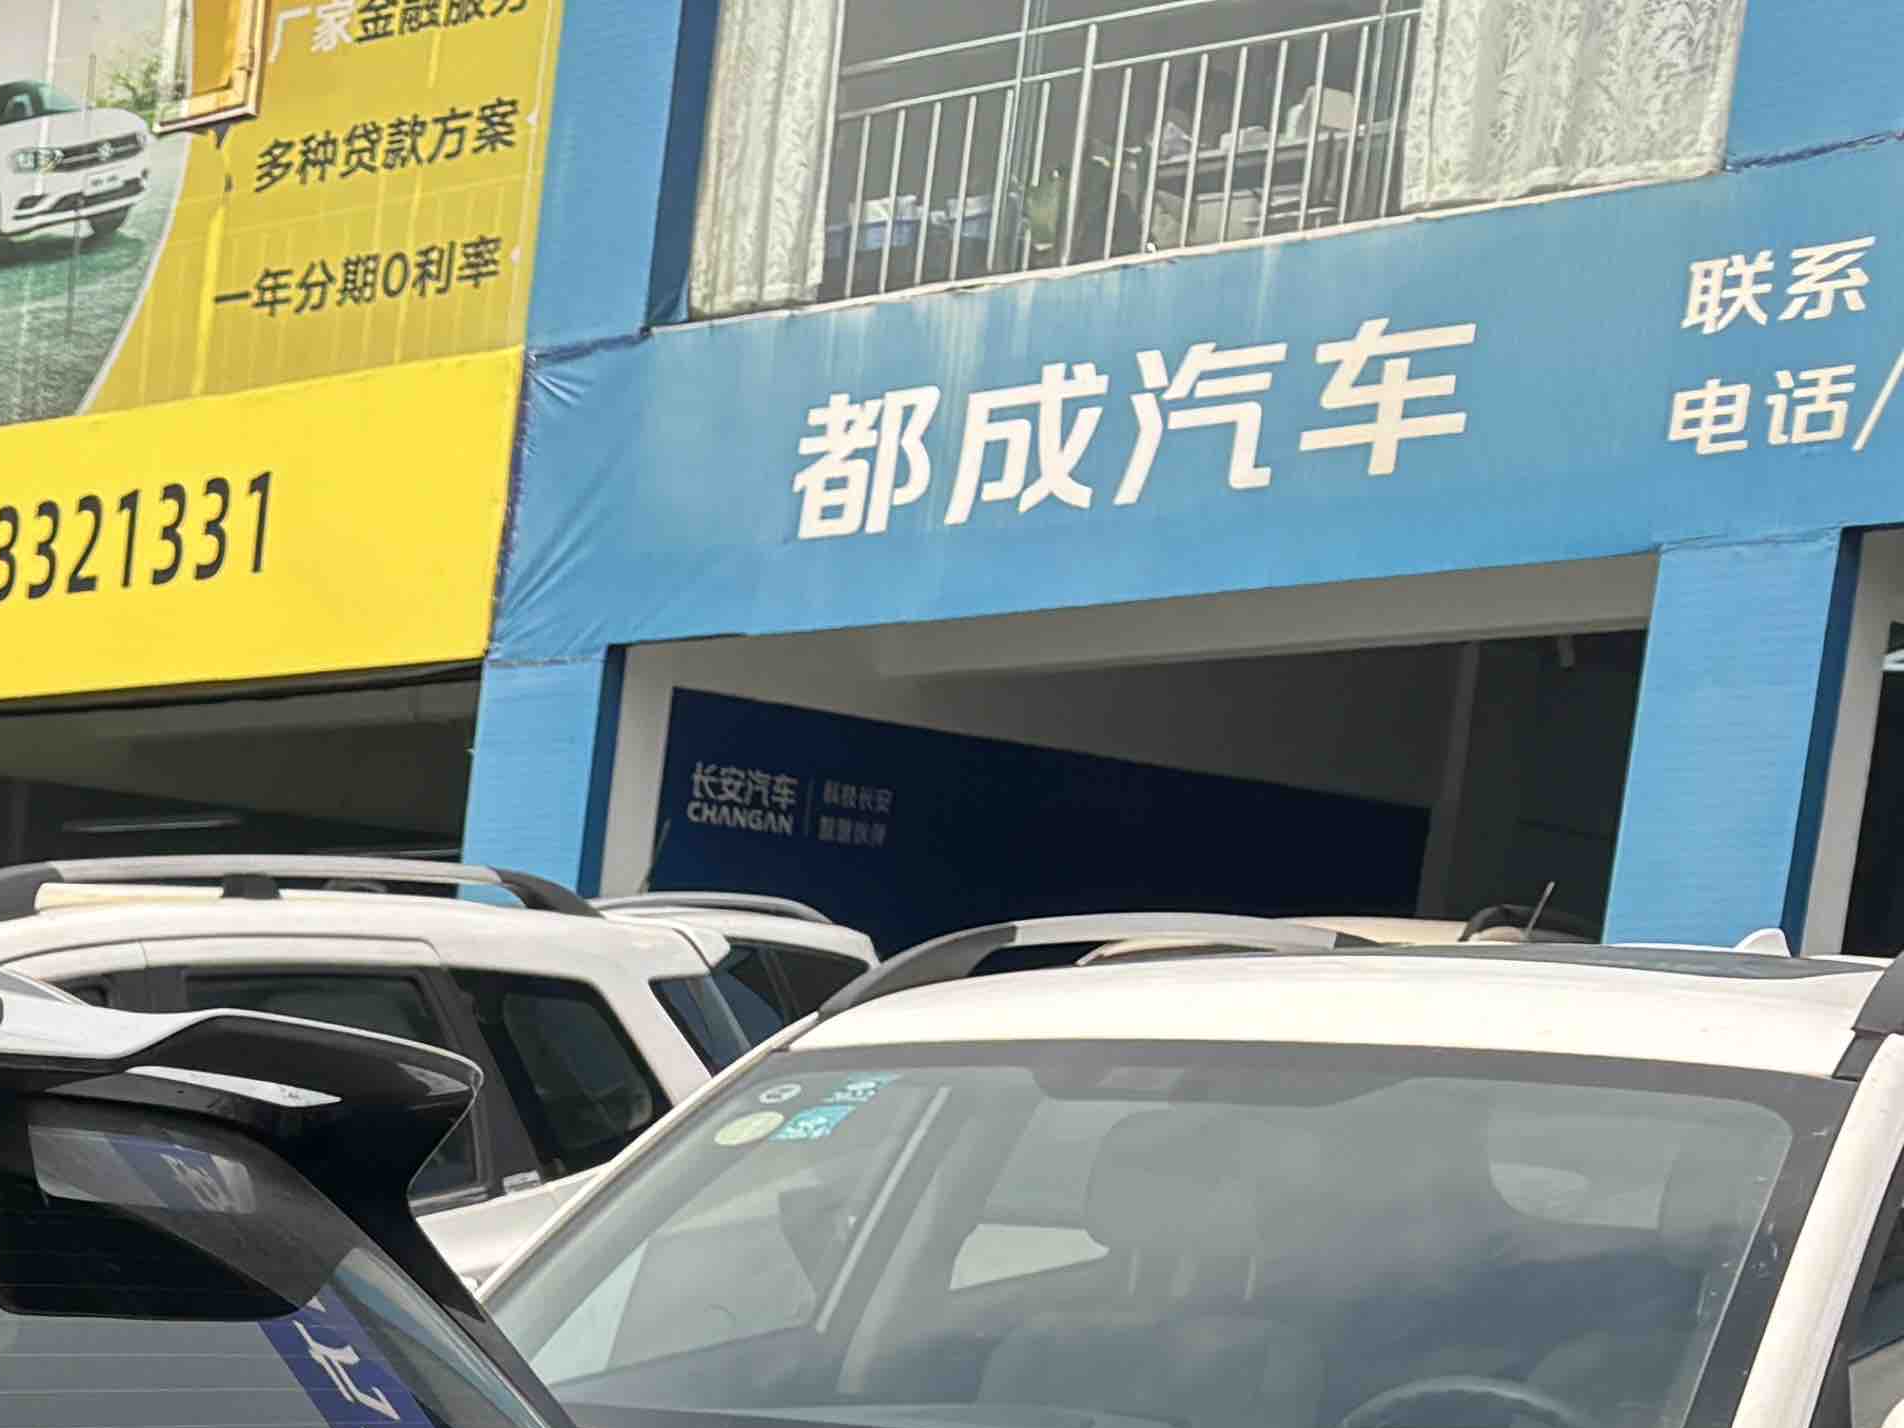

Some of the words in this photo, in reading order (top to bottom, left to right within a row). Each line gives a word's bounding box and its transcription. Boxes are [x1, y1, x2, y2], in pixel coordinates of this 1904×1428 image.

[268, 0, 529, 64] 厂家金融服
[254, 97, 519, 193] 多种贷款方案
[213, 234, 504, 319] 一年分期0利率
[1680, 235, 1877, 336] 联系
[791, 314, 1477, 543] 都成汽车
[686, 801, 794, 836] CHANGAN
[691, 760, 799, 810] 长安汽车
